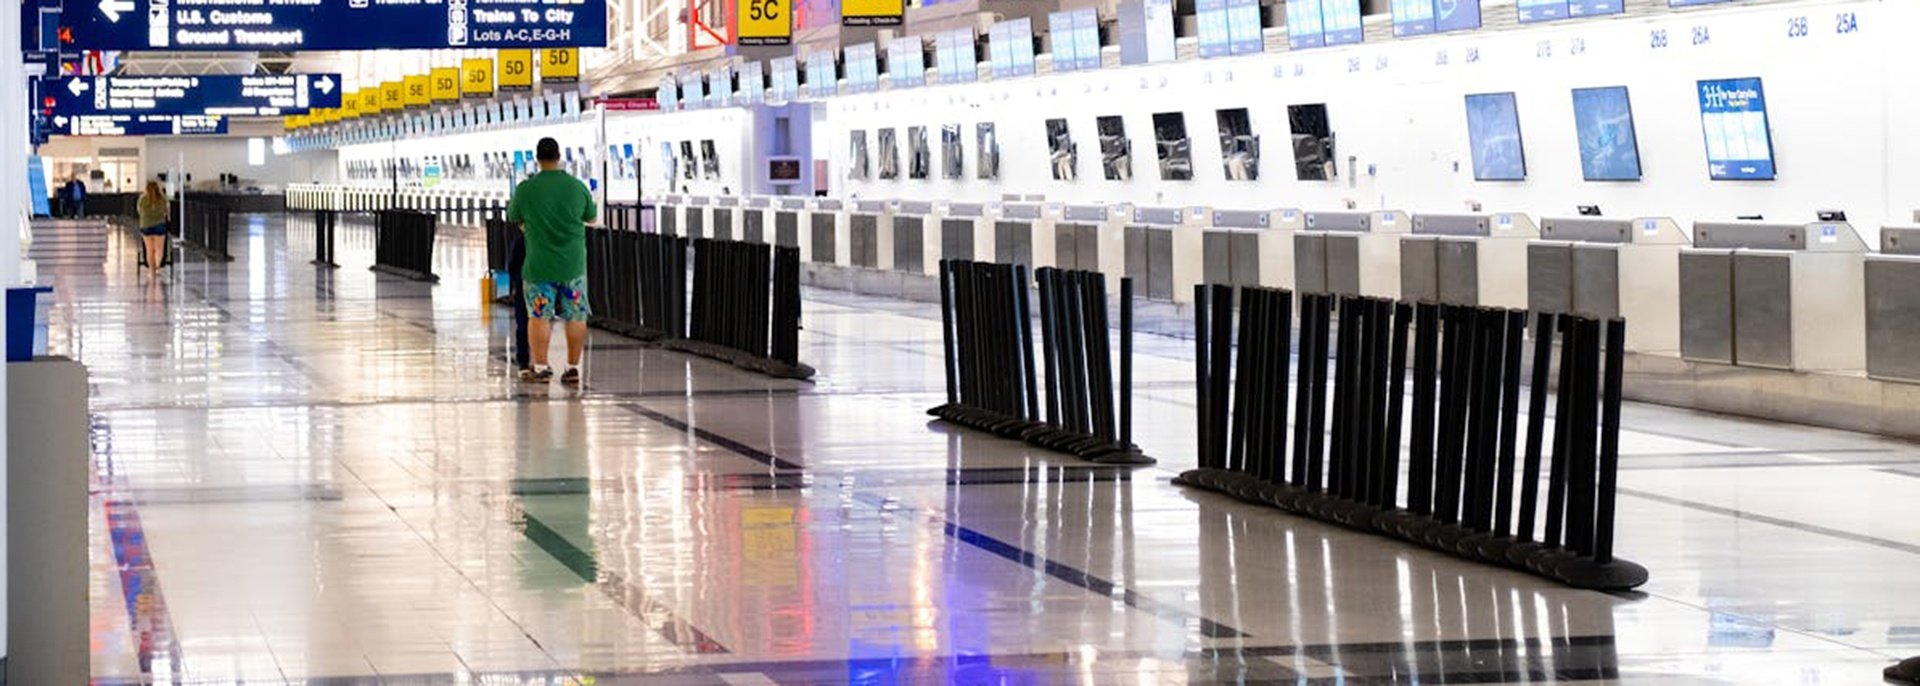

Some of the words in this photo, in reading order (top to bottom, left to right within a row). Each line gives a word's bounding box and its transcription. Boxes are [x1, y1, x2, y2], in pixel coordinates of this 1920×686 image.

[210, 10, 273, 24] Customs
[473, 9, 516, 23] Trains
[521, 9, 540, 23] To
[545, 9, 575, 24] City
[750, 0, 779, 20] 5C
[1787, 16, 1809, 38] 25B
[1835, 12, 1858, 34] 25A
[176, 29, 230, 45] Ground
[233, 29, 303, 46] Transport
[473, 29, 501, 42] Lots
[504, 29, 571, 42] A-C,E-G-H
[549, 49, 569, 65] 5D
[505, 60, 524, 75] 5D
[468, 69, 486, 83] 5D
[437, 78, 453, 91] 5D
